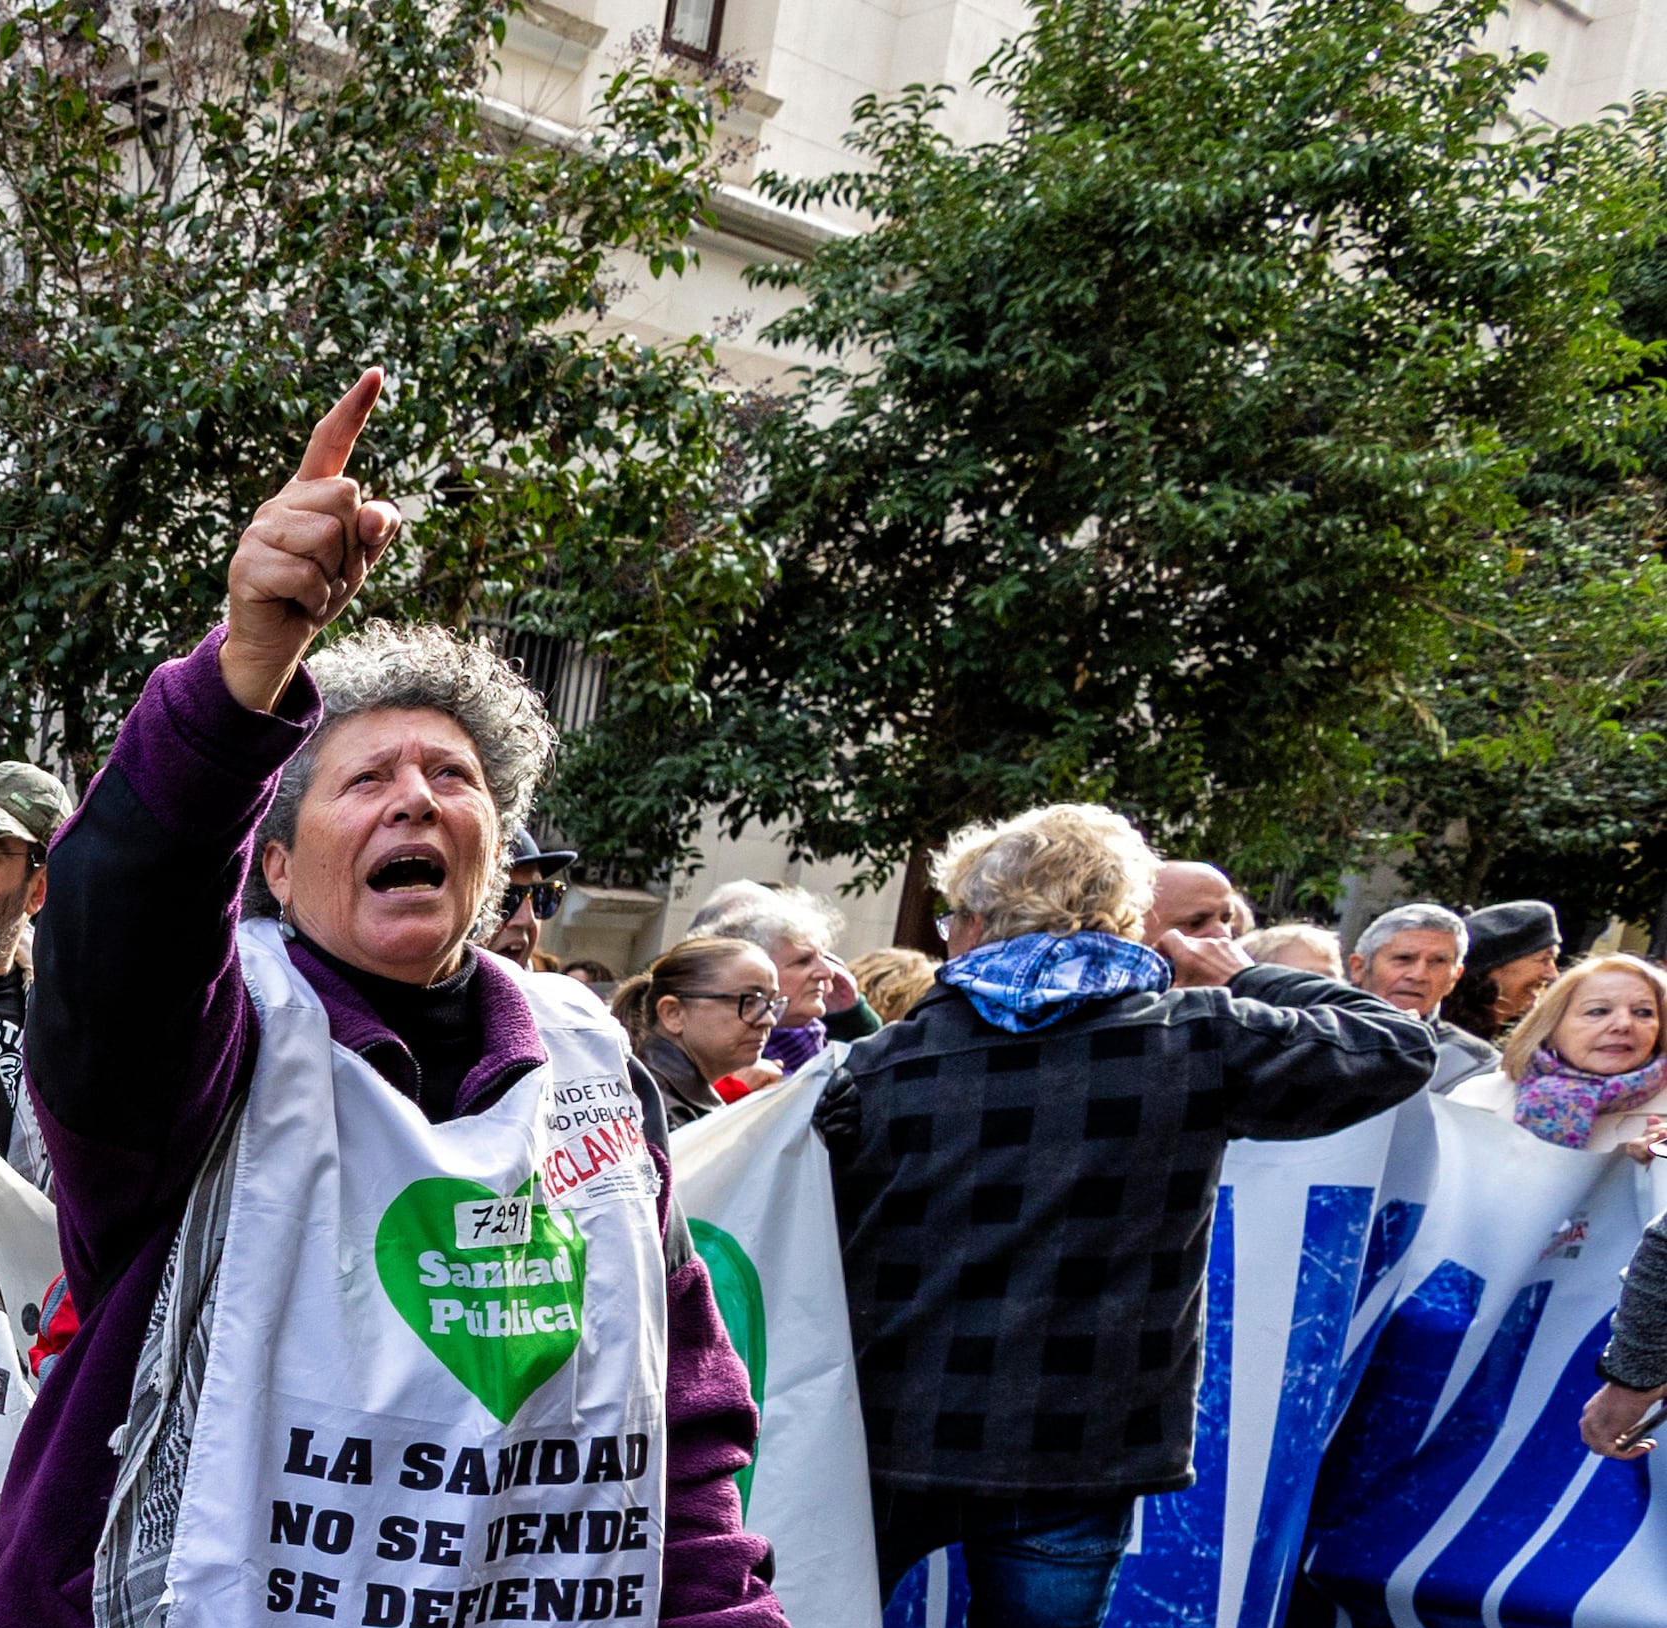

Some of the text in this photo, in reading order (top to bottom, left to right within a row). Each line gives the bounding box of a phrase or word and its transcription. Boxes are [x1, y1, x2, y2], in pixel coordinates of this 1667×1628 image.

[597, 1081, 620, 1098] TU
[573, 1105, 638, 1127] PÚBLICA
[471, 1200, 528, 1240] 7291
[418, 1247, 573, 1289] Sanidad
[428, 1298, 578, 1338] Pública
[283, 1427, 649, 1496] LA SANIDAD
[270, 1500, 650, 1567] NO SE VENDE
[267, 1567, 340, 1620] SE
